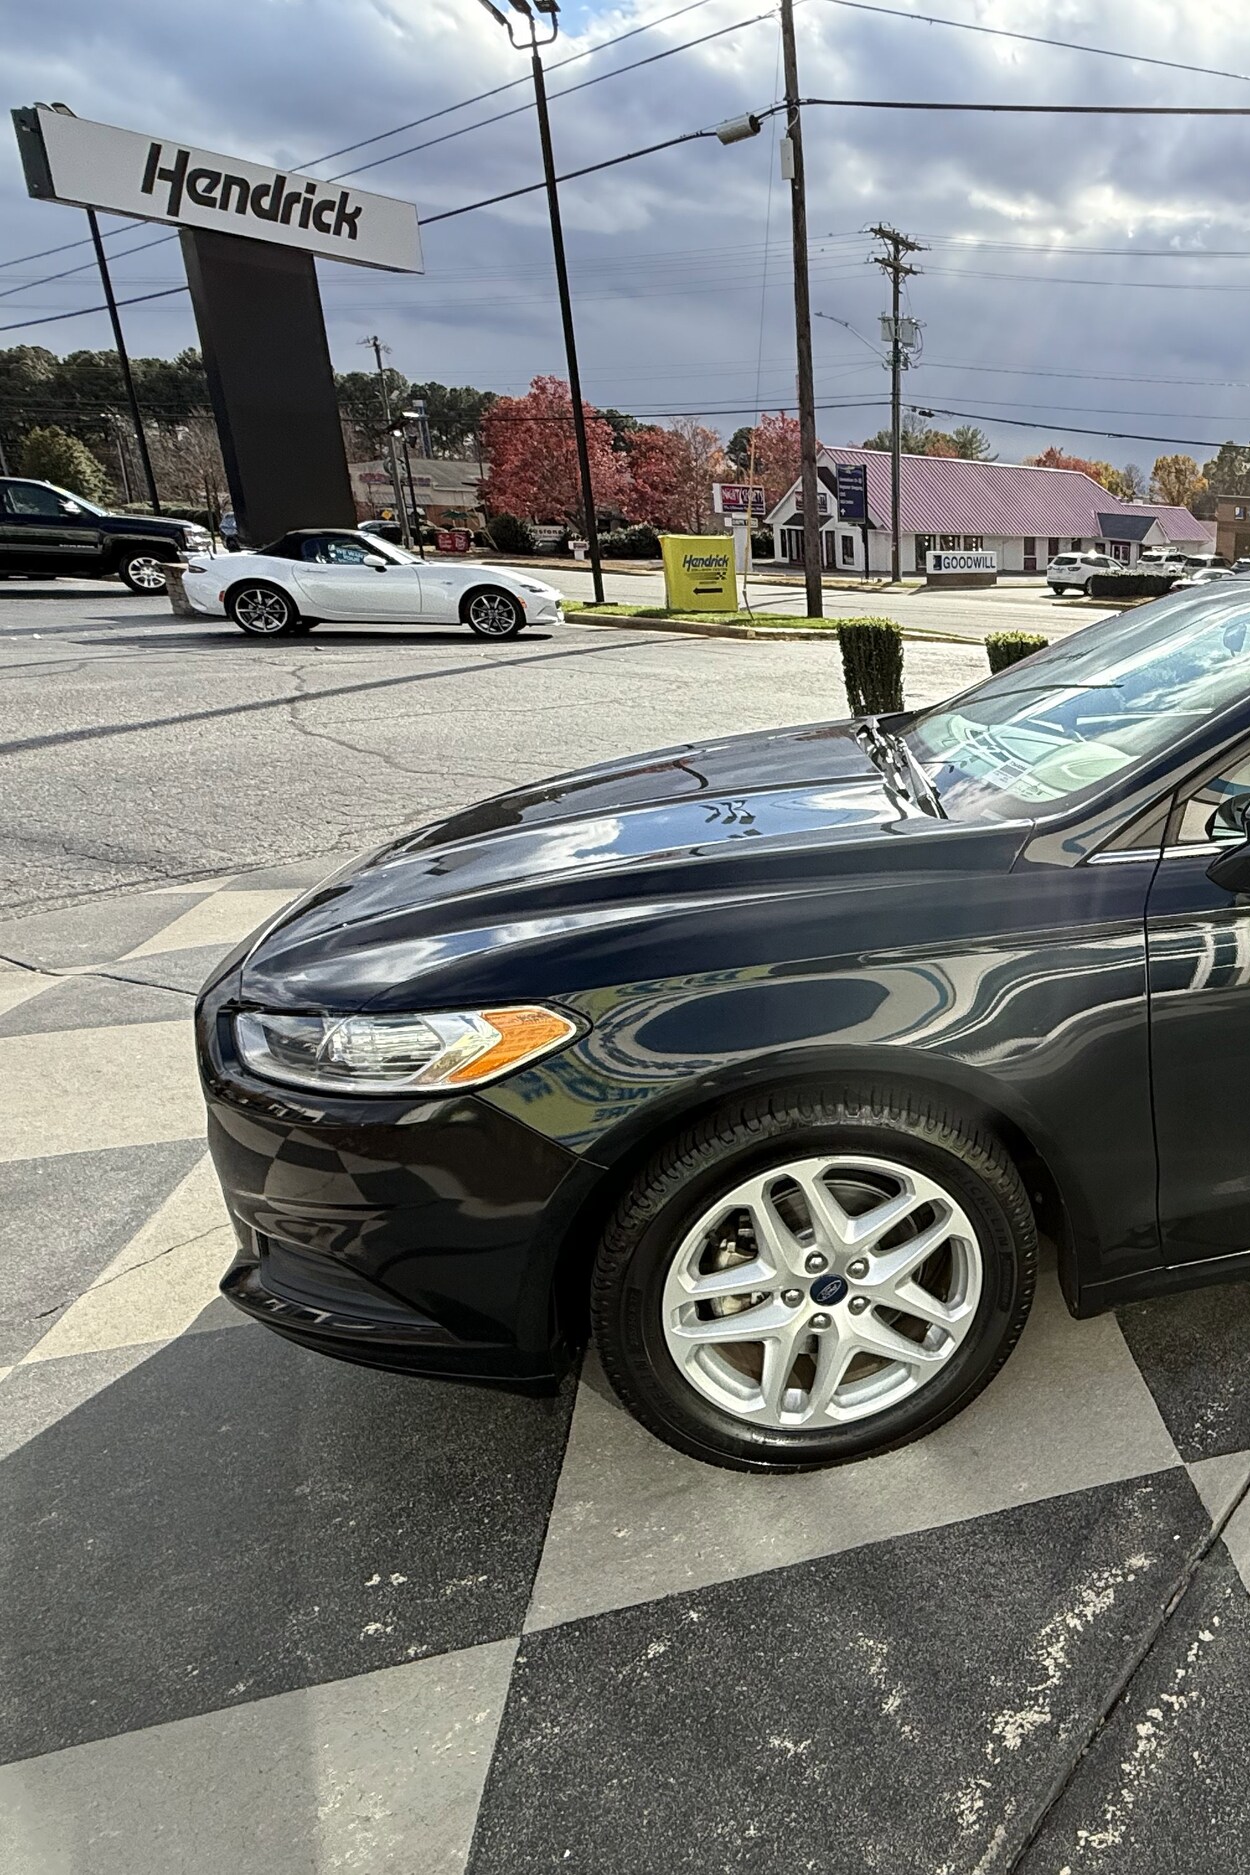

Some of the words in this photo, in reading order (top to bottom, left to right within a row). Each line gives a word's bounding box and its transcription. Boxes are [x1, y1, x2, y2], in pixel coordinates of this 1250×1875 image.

[141, 142, 363, 240] Hendrick
[682, 554, 729, 572] Hendrick
[943, 556, 996, 569] GOODWILL
